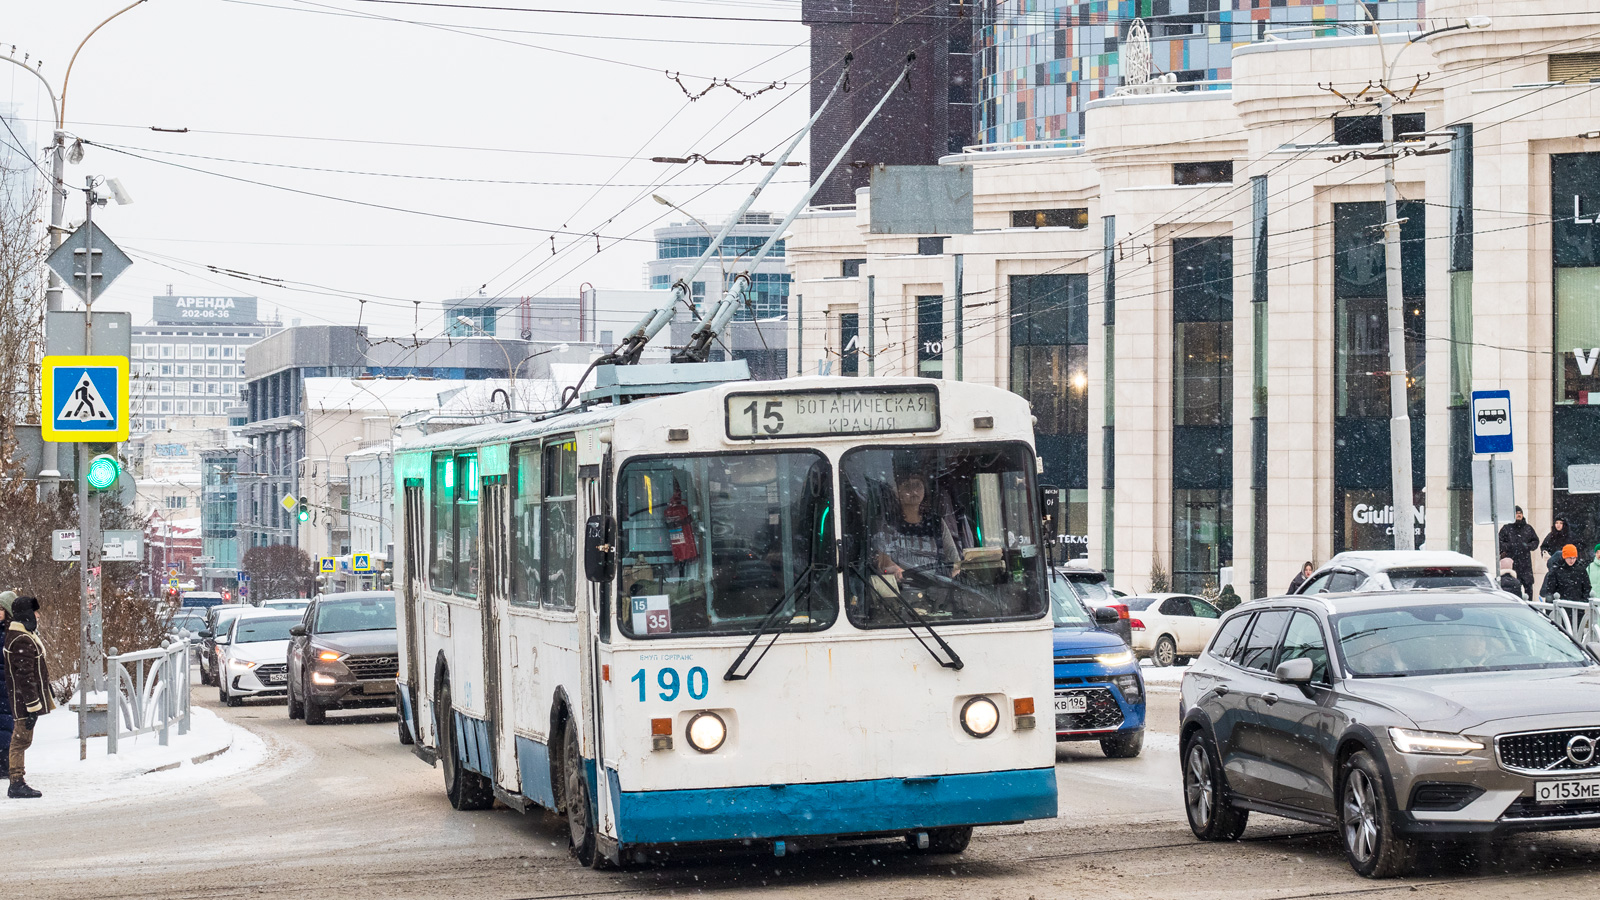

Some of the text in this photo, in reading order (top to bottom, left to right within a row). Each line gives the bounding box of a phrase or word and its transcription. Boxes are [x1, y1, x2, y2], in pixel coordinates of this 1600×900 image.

[176, 297, 235, 310] АРЕНДА
[181, 309, 230, 318] 202-06-36
[796, 397, 927, 414] БОТАНИЧЕСКАЯ
[743, 400, 784, 434] 15
[634, 600, 646, 610] 15
[649, 615, 668, 628] 35
[631, 666, 709, 702] 190
[1069, 698, 1085, 706] 196
